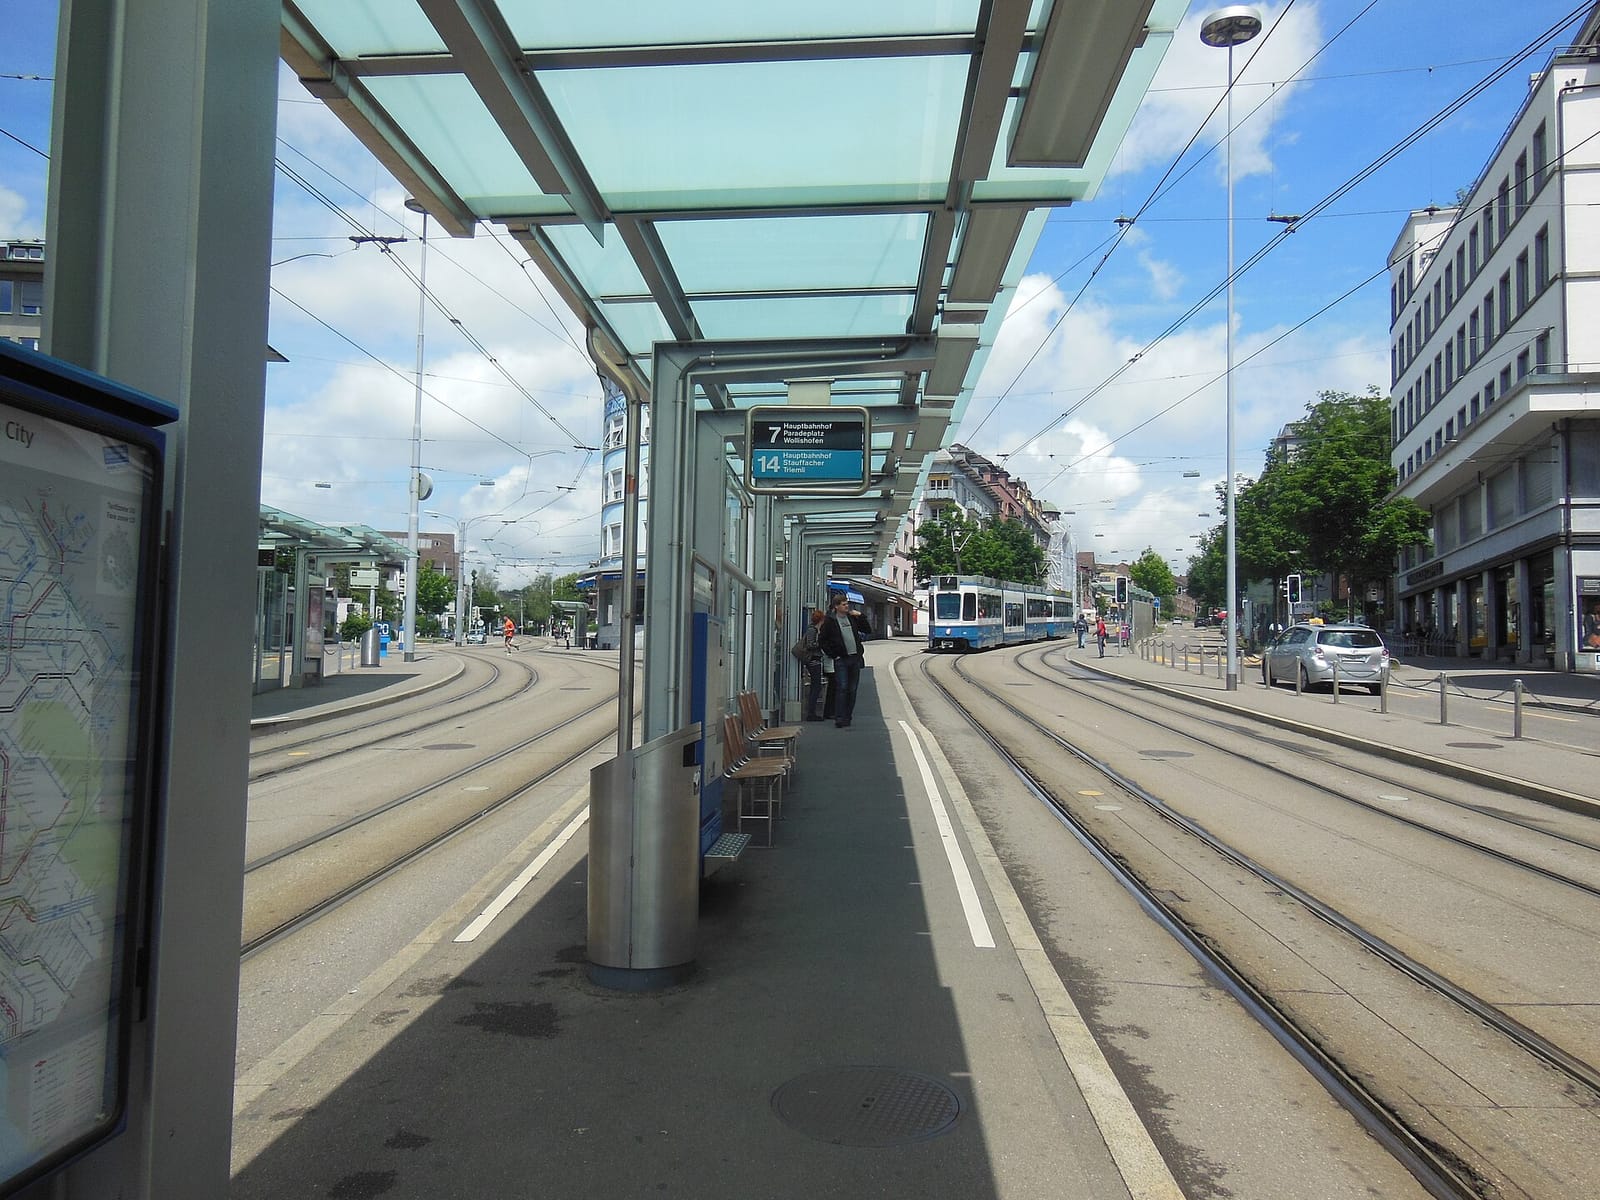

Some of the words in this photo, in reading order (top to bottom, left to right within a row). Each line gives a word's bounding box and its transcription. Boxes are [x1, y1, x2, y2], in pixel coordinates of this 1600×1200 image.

[6, 421, 34, 448] City
[768, 426, 781, 443] 7
[783, 430, 824, 438] Paradeplatz
[757, 456, 780, 473] 14
